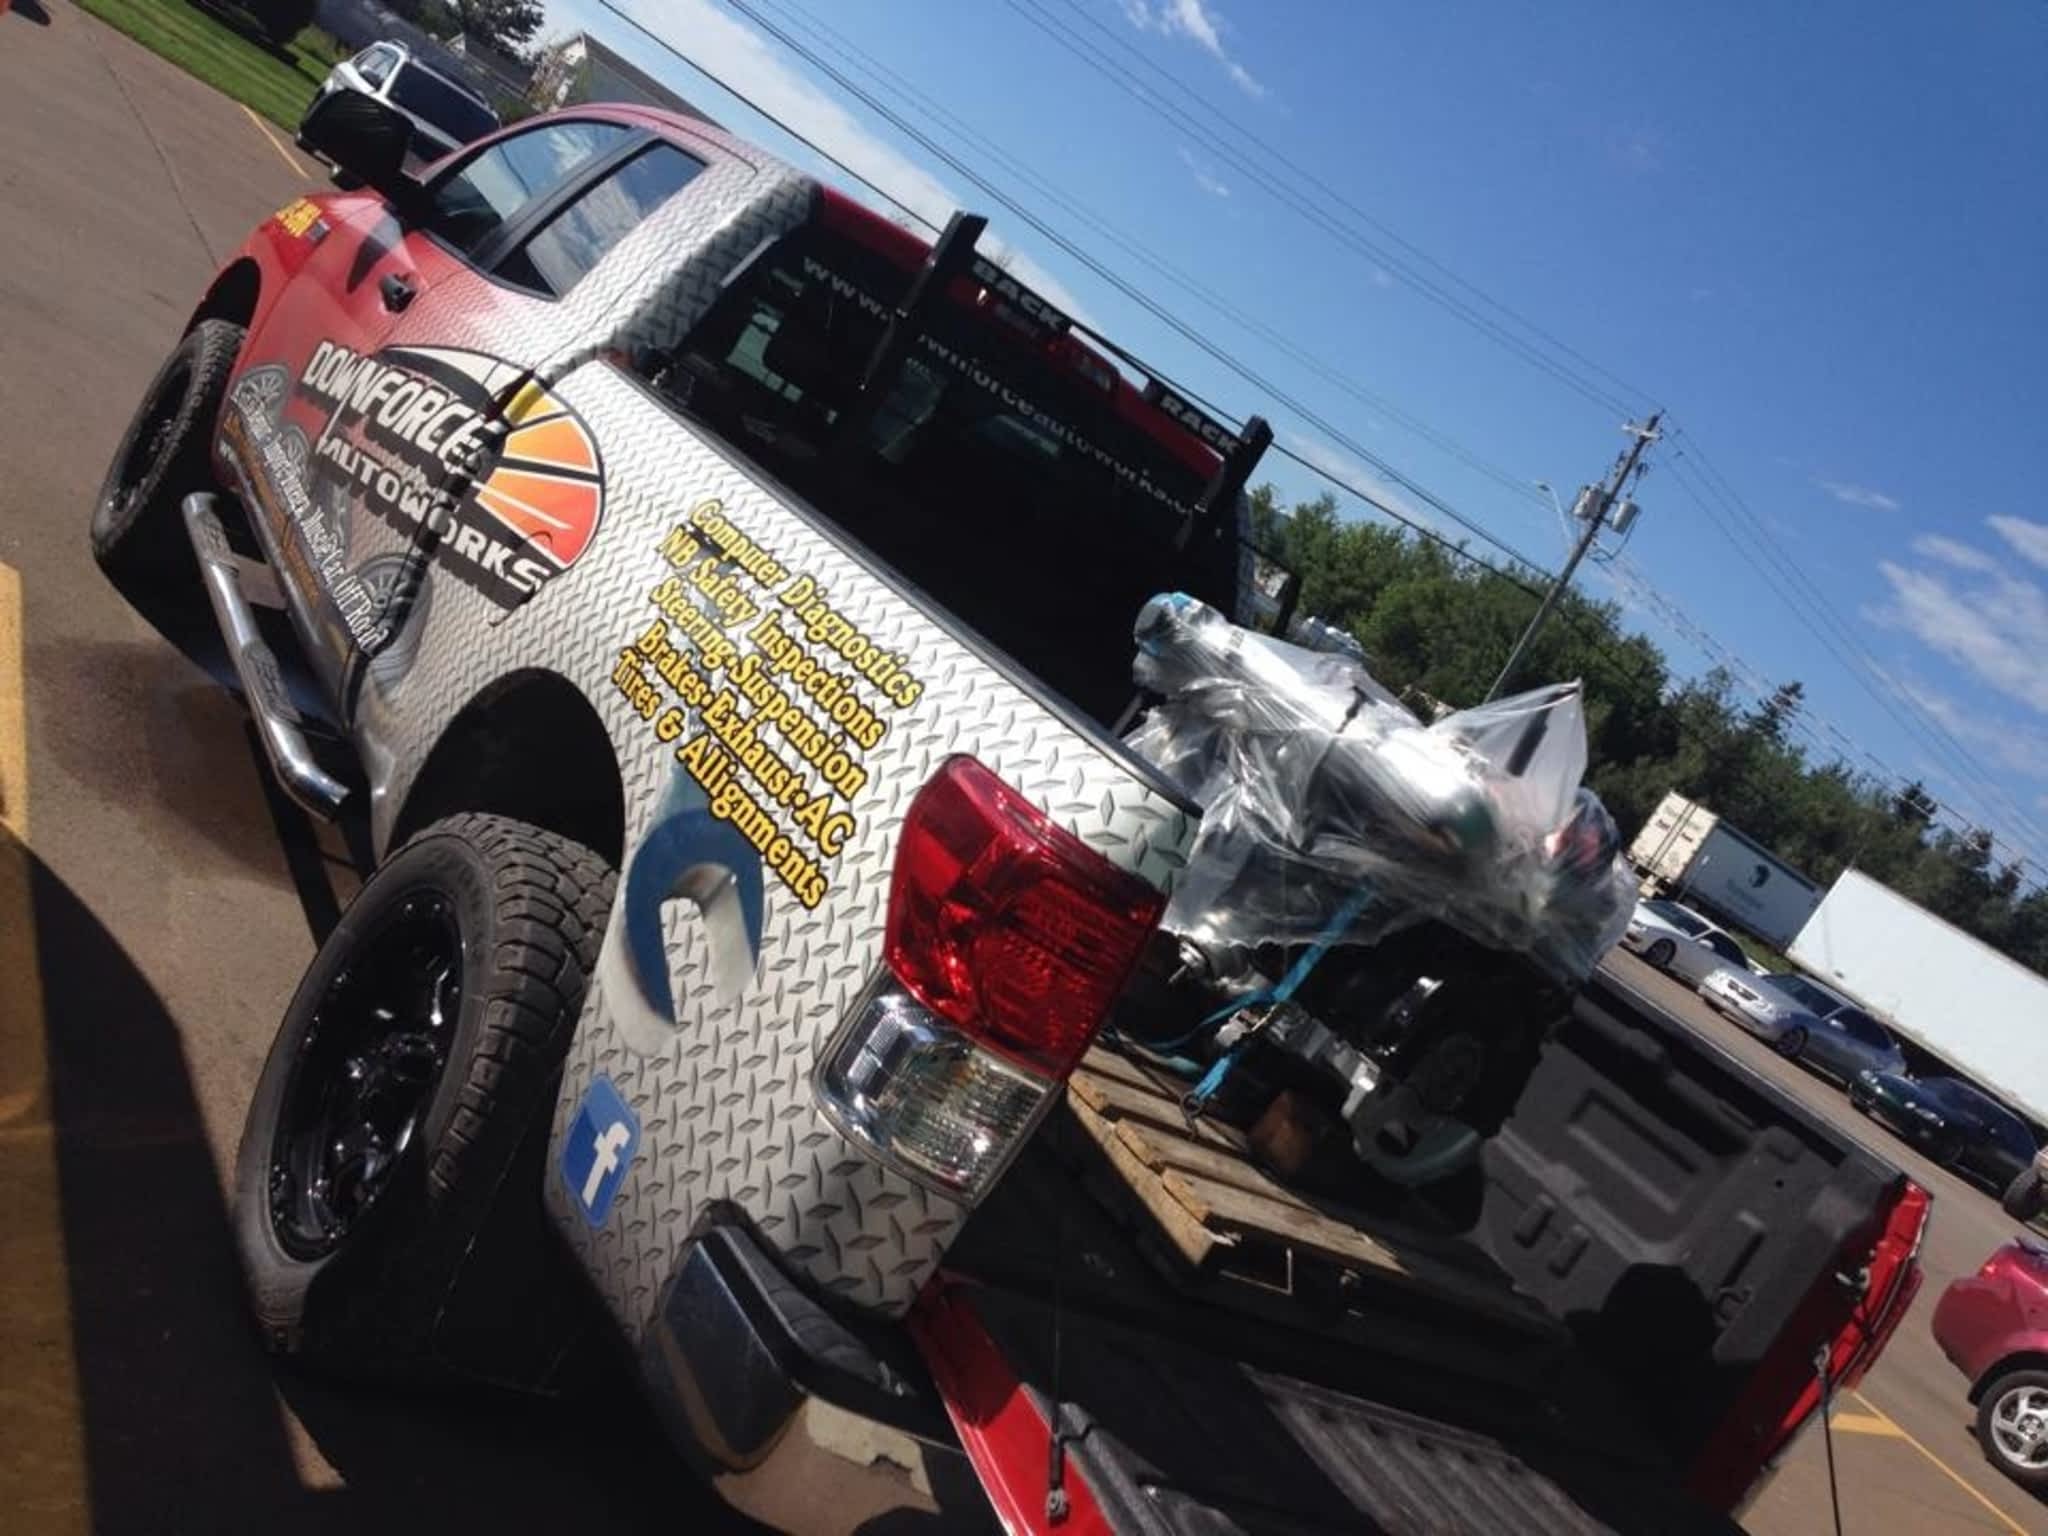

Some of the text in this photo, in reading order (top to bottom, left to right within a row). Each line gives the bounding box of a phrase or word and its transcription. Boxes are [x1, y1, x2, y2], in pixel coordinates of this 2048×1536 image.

[303, 341, 507, 474] DOWNFORCE
[971, 259, 1242, 454] BACK RACK
[318, 434, 552, 593] AUTOWORKS
[689, 500, 925, 708] Computer Diagnostics
[656, 524, 887, 750] NB Safety Inspections
[611, 647, 828, 909] Tires & Allignments
